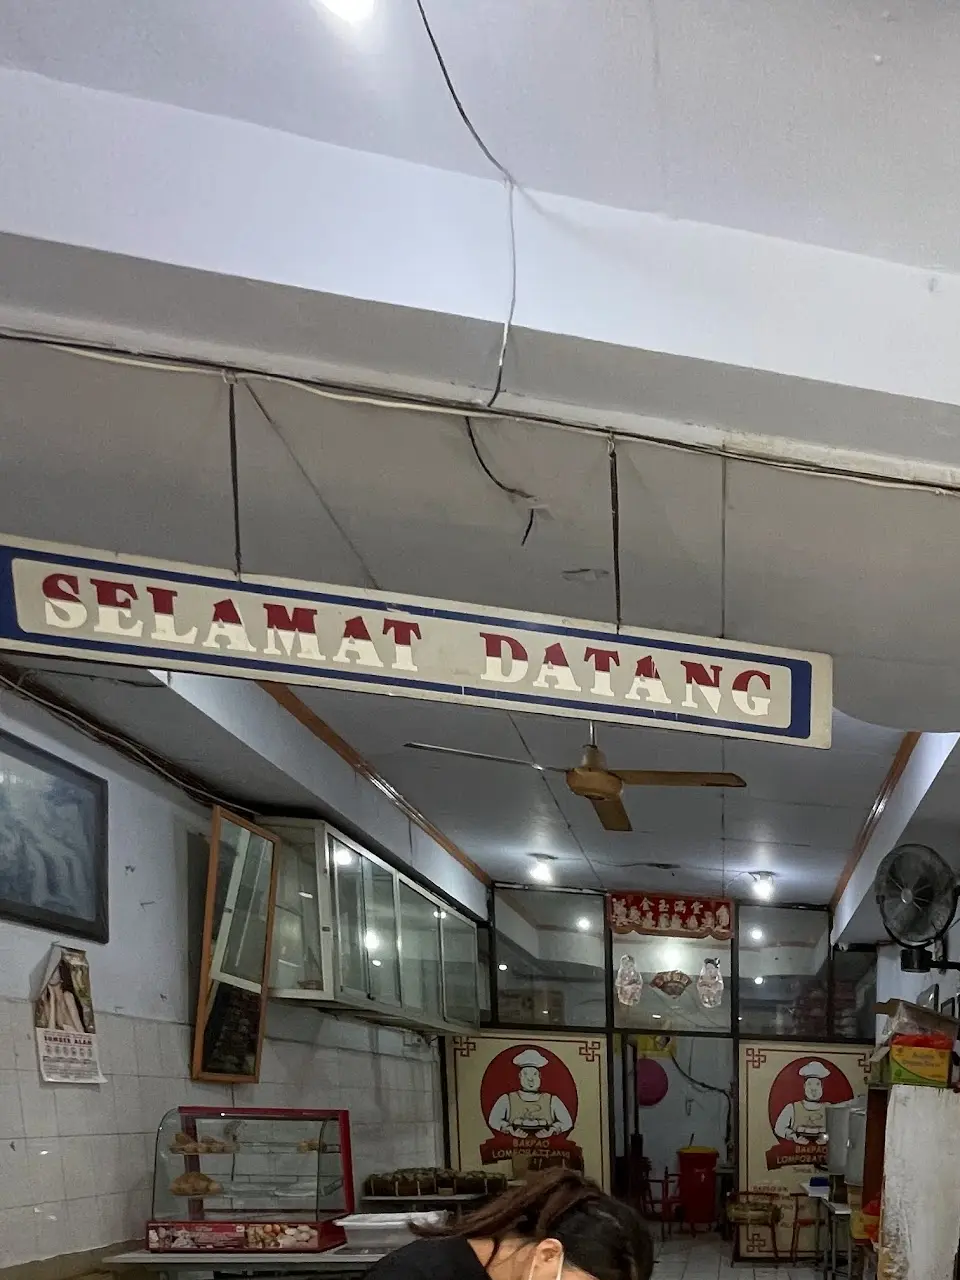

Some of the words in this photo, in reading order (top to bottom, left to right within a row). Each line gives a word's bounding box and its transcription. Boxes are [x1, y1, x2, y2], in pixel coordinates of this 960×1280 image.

[42, 572, 422, 673] SELAMAT
[479, 631, 772, 717] DATANG
[512, 1139, 550, 1149] BAKPAO
[795, 1145, 829, 1155] BAKPAO
